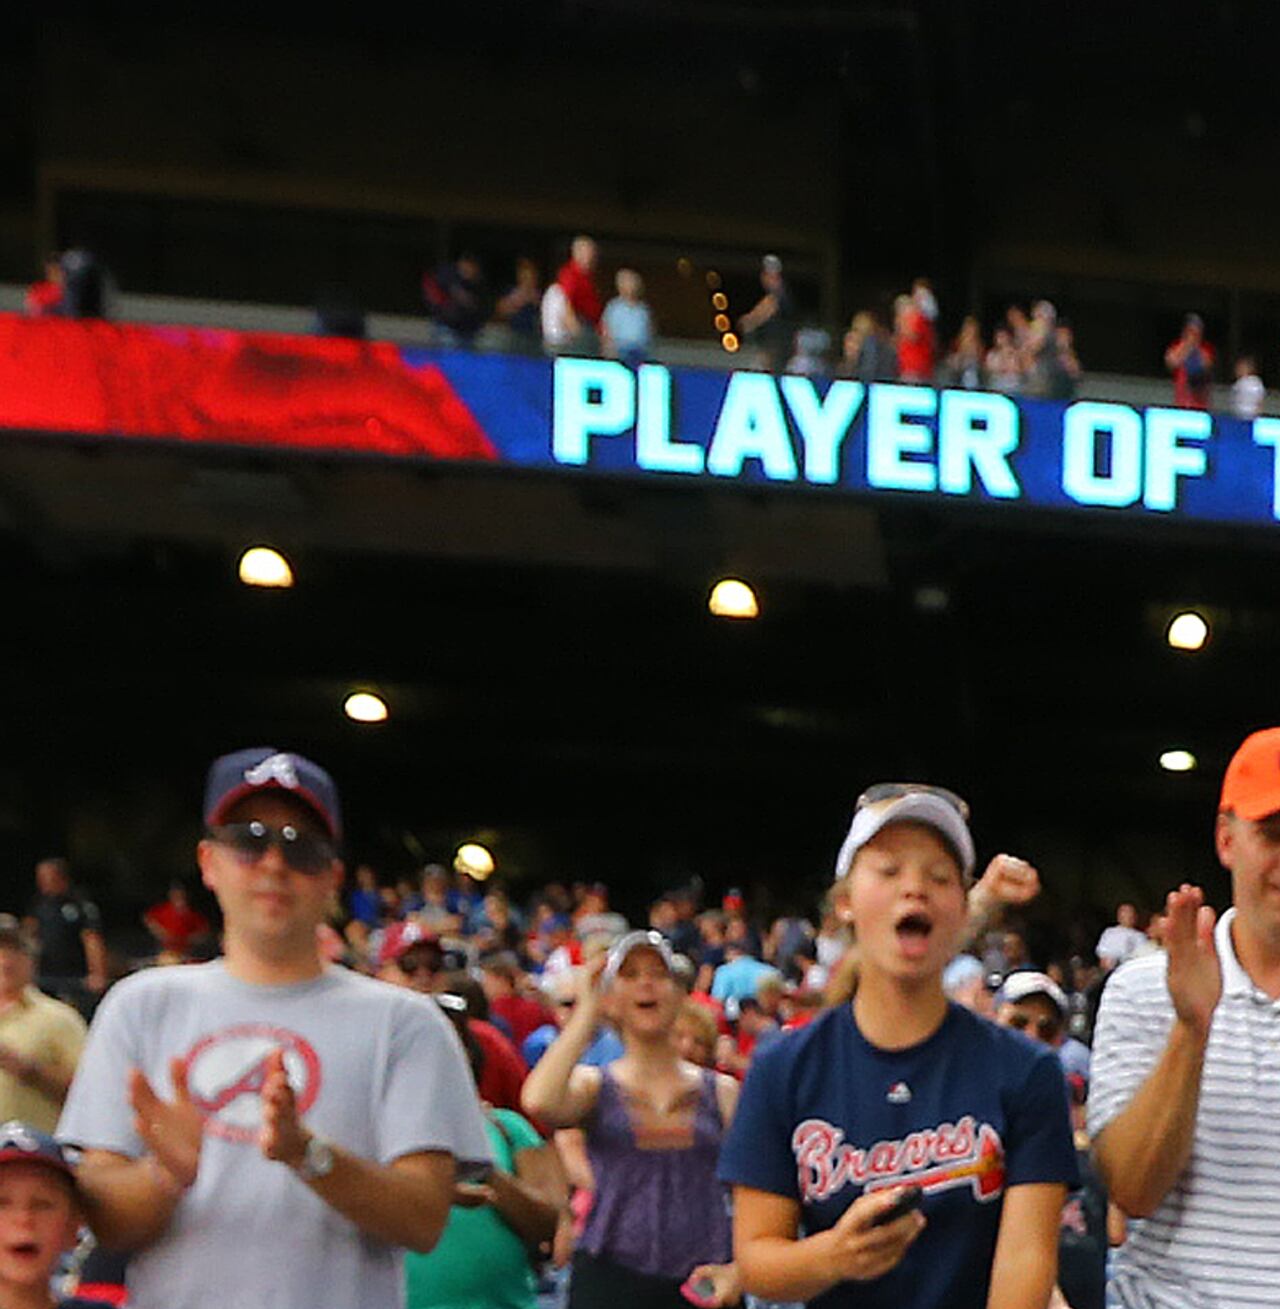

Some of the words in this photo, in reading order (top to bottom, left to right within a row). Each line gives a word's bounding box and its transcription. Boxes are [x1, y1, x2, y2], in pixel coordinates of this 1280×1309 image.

[552, 355, 1021, 499] PLAYER
[1061, 400, 1213, 511] OF
[791, 1116, 978, 1203] Braves
